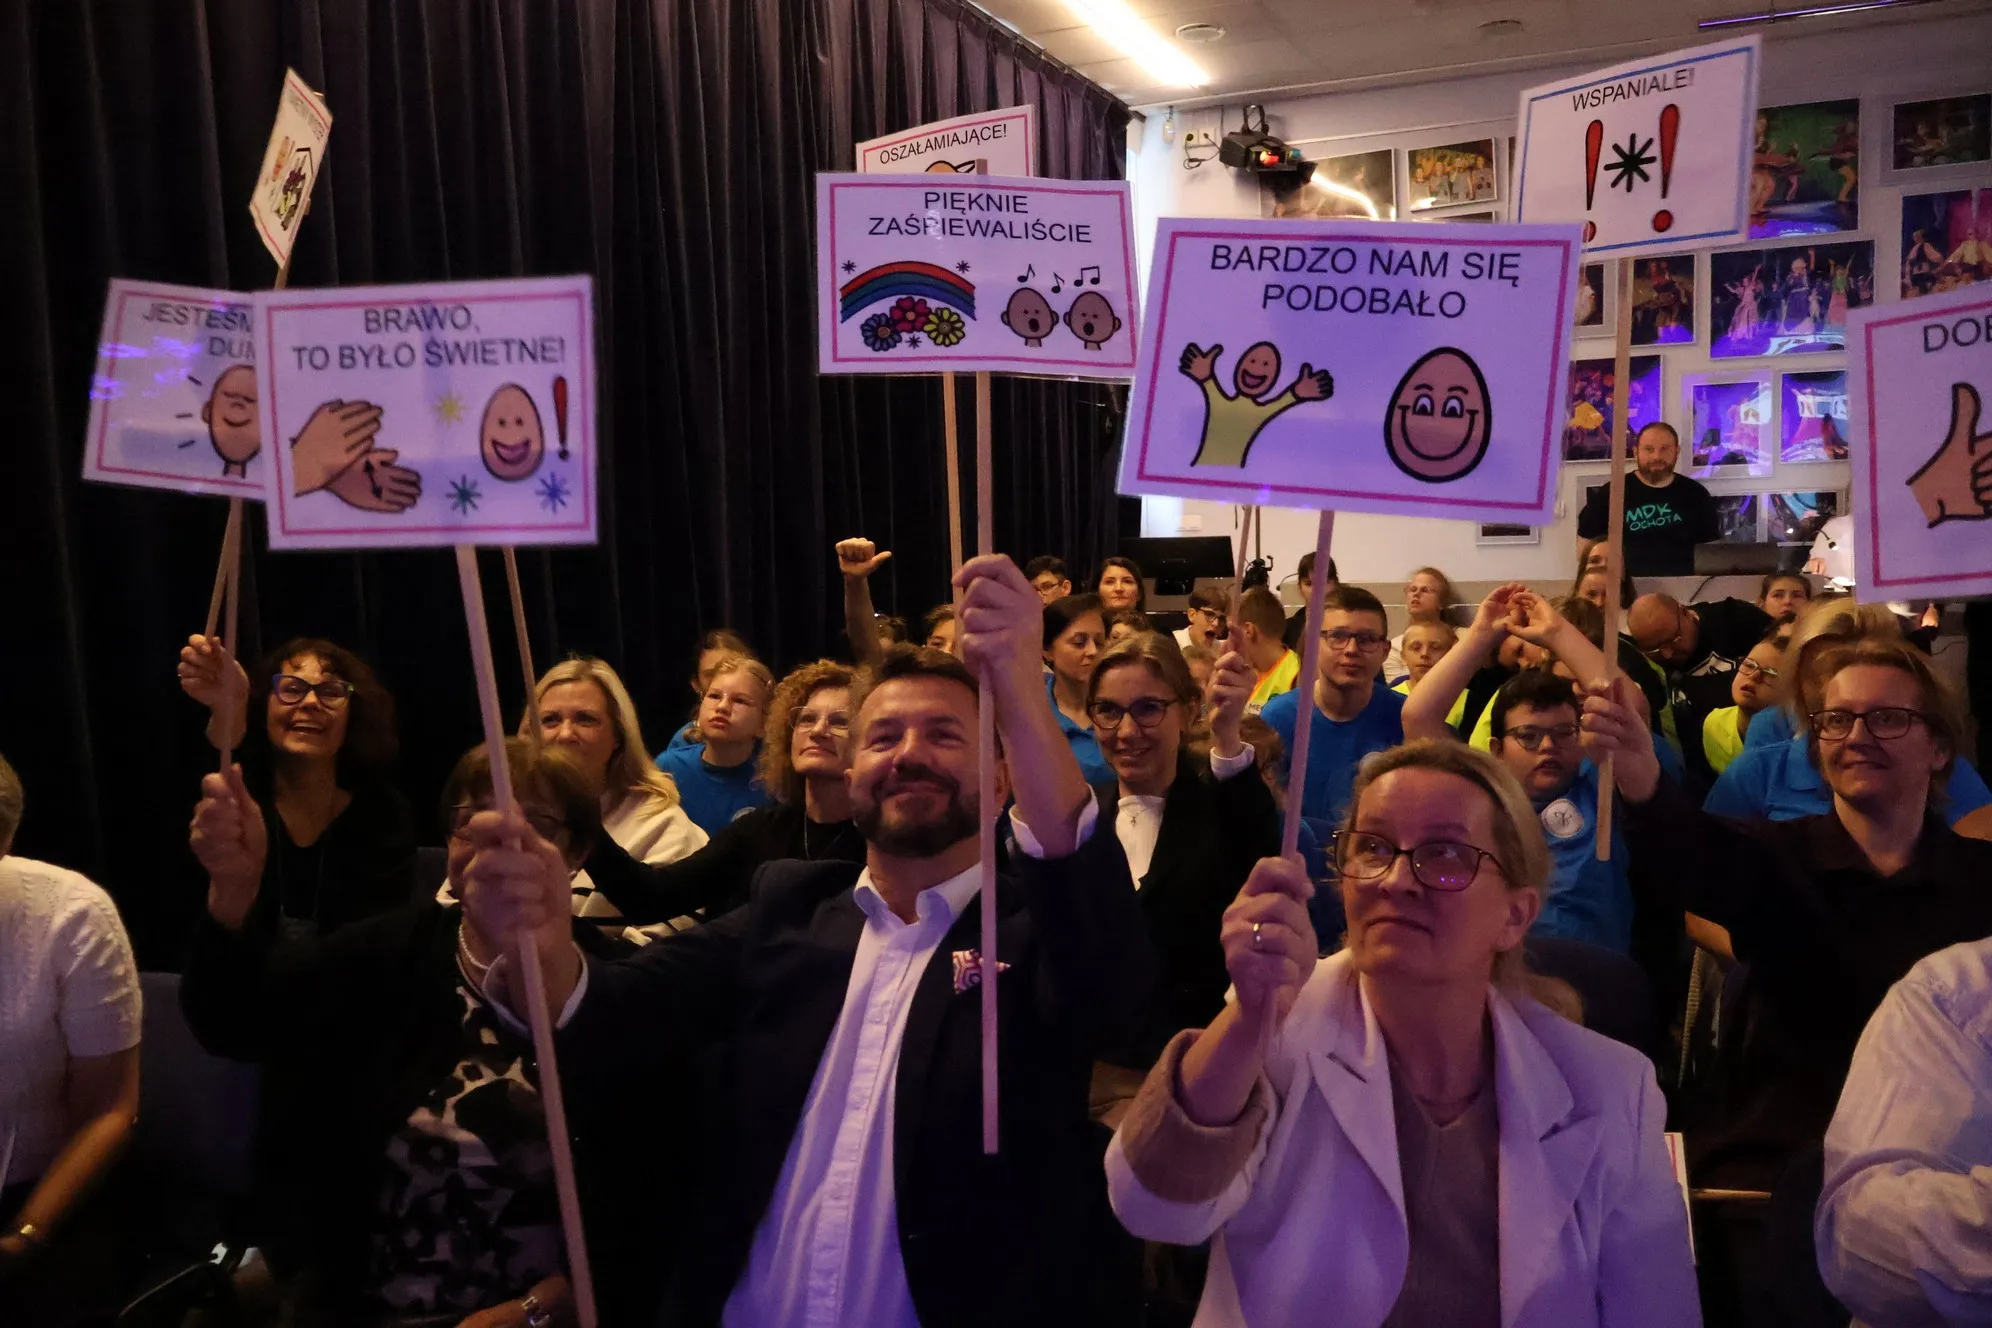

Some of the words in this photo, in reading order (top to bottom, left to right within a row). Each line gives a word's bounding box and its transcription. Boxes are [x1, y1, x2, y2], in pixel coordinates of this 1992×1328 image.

[1572, 67, 1695, 112] WSPANIALE!
[880, 124, 1007, 164] OSZAŁAMIAJĄCE!
[924, 192, 1028, 215] PIĘKNIE
[868, 213, 1092, 243] ZAŚPIEWALIŚCIE
[1210, 244, 1356, 274] BARDZO
[1369, 250, 1449, 278] NAM
[1461, 252, 1521, 287] SIĘ
[1262, 284, 1466, 318] PODOBAŁO
[364, 305, 480, 334] BRAWO,
[292, 346, 330, 370] TO
[338, 342, 416, 369] BYŁO
[424, 336, 565, 367] ŚWIETNE!
[1626, 503, 1672, 522] MDK
[1629, 513, 1682, 531] OCHOTA
